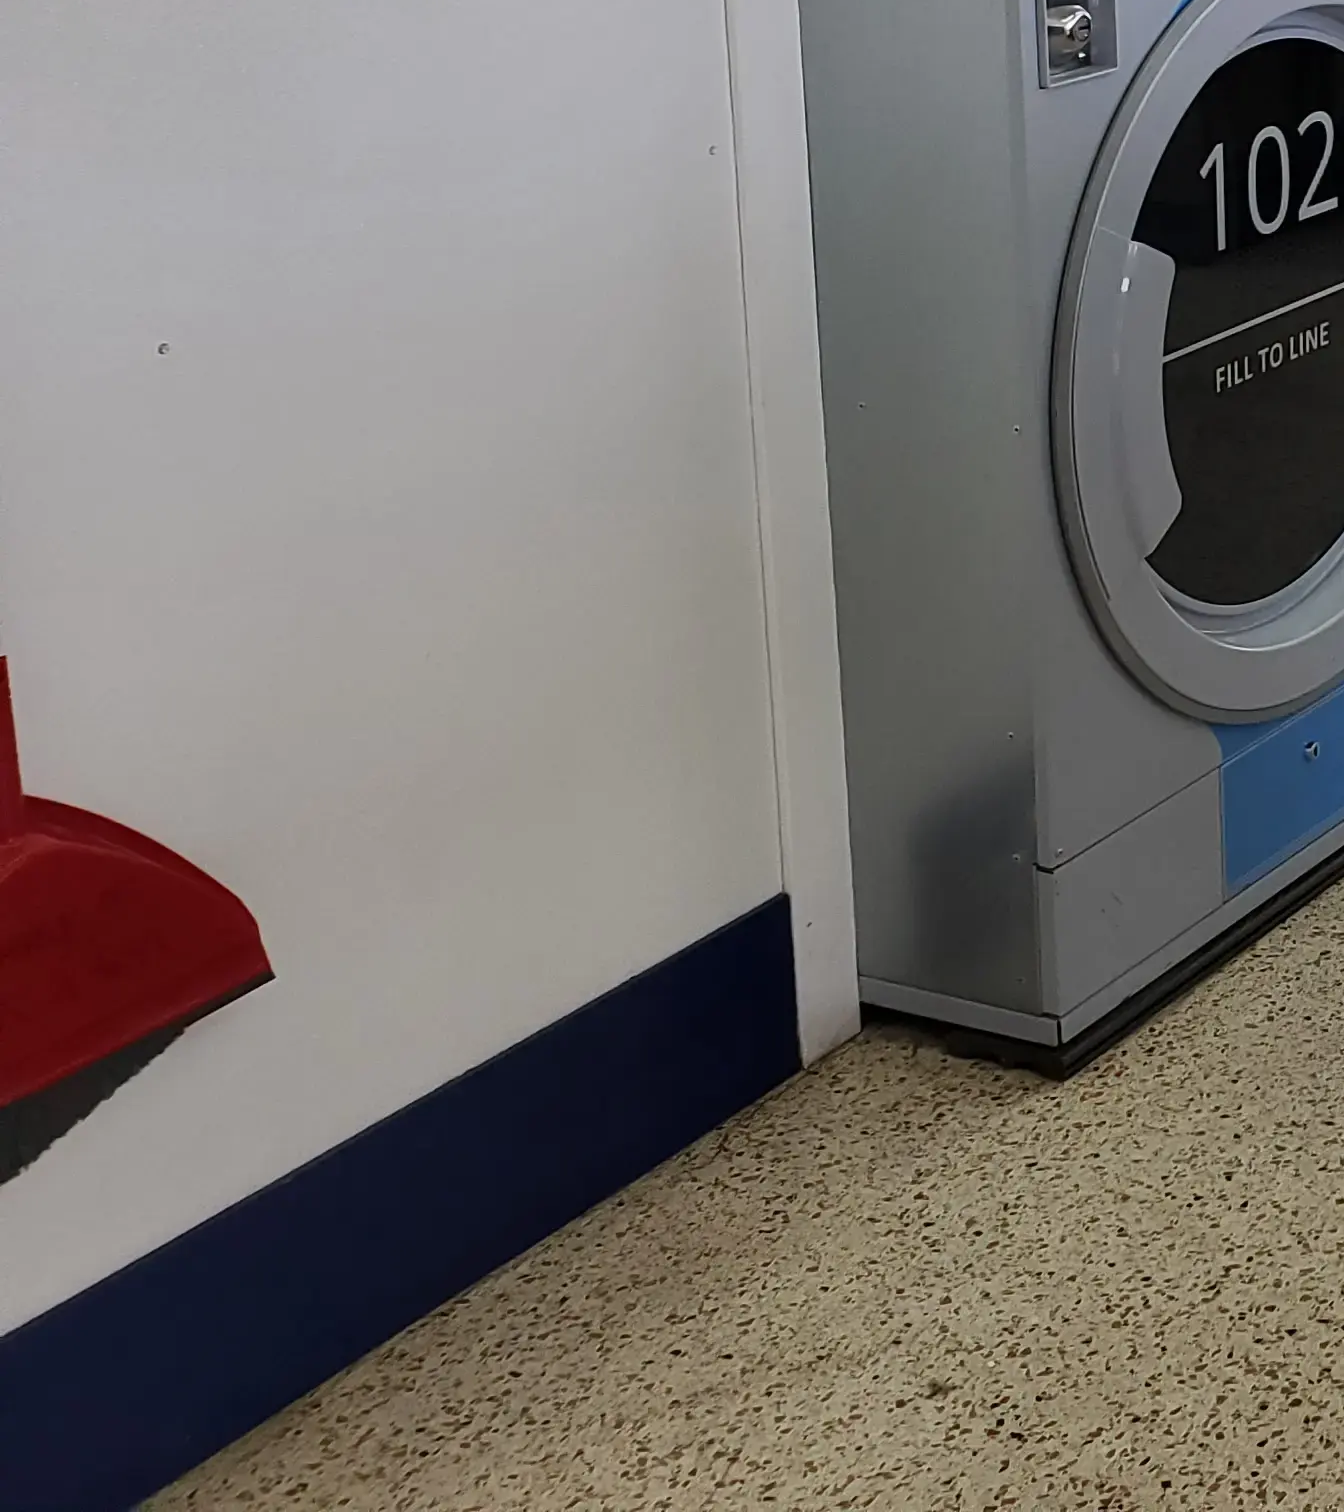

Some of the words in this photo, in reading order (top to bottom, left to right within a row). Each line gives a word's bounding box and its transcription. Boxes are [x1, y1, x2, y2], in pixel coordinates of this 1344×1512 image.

[1200, 110, 1339, 252] 102
[1216, 356, 1254, 393] FILL
[1258, 342, 1283, 373] TO
[1289, 321, 1330, 361] LINE
